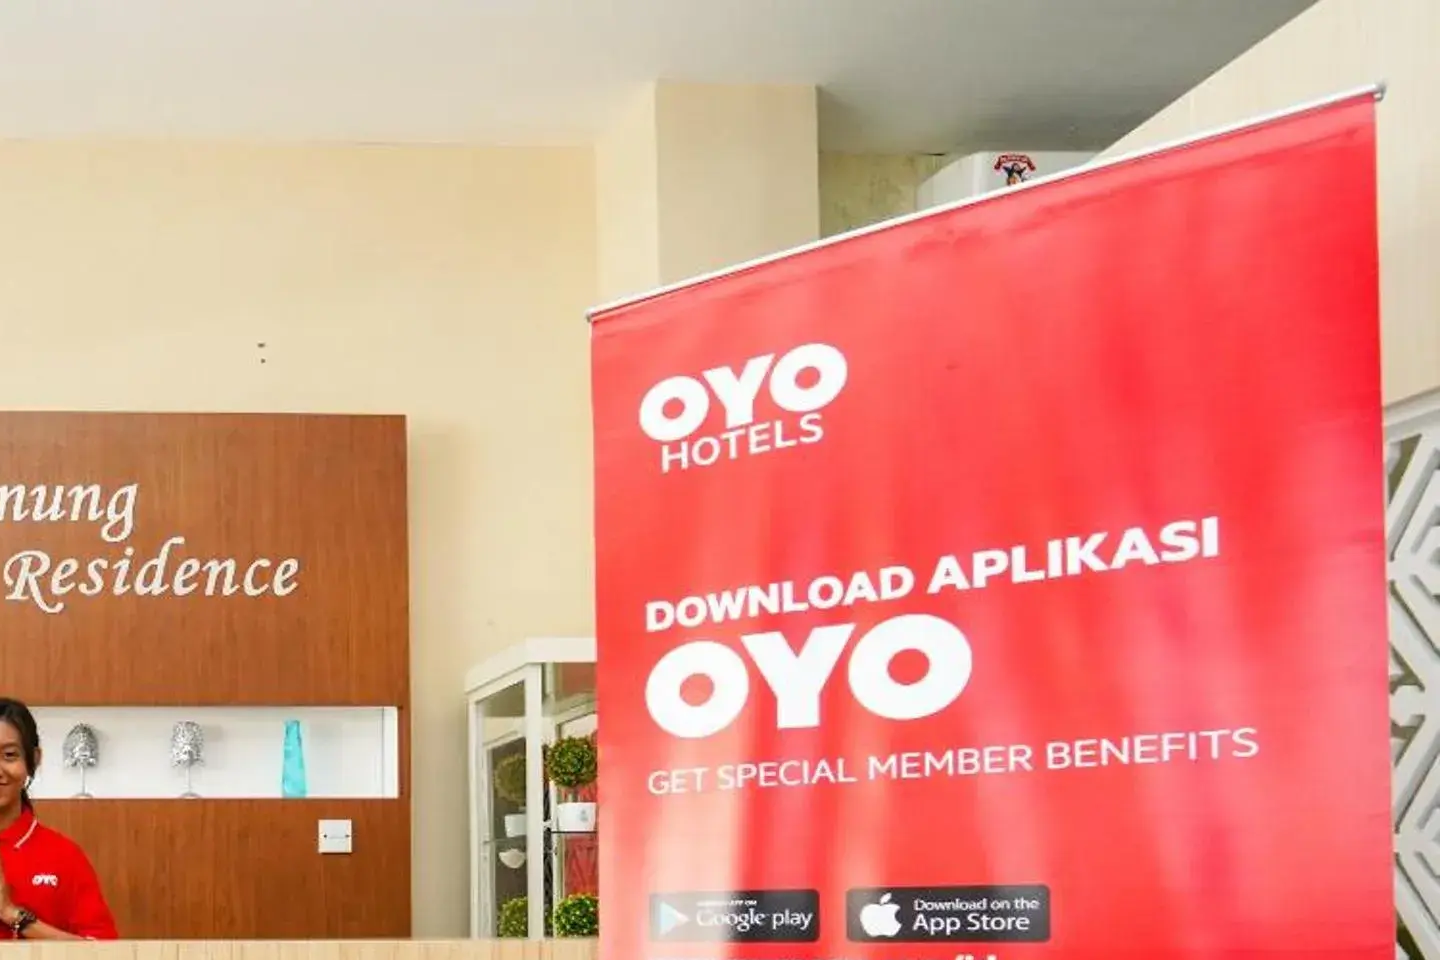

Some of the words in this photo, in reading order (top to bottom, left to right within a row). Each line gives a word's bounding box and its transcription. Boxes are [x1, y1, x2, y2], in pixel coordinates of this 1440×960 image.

[639, 343, 848, 442] OYO
[661, 413, 824, 472] HOTELS
[3, 536, 300, 613] Residence
[646, 566, 914, 632] DOWNLOAD
[927, 516, 1219, 594] APLIKASI
[646, 614, 972, 739] OYO
[647, 765, 707, 796] GET
[717, 758, 858, 789] SPECIAL
[867, 744, 1034, 781] MEMBER
[1046, 727, 1260, 769] BENEFITS
[696, 908, 766, 932] Google
[771, 908, 814, 930] play
[912, 913, 960, 935] App
[967, 912, 1031, 931] Store
[913, 898, 988, 911] Download
[991, 899, 1011, 910] on
[1014, 896, 1041, 910] the
